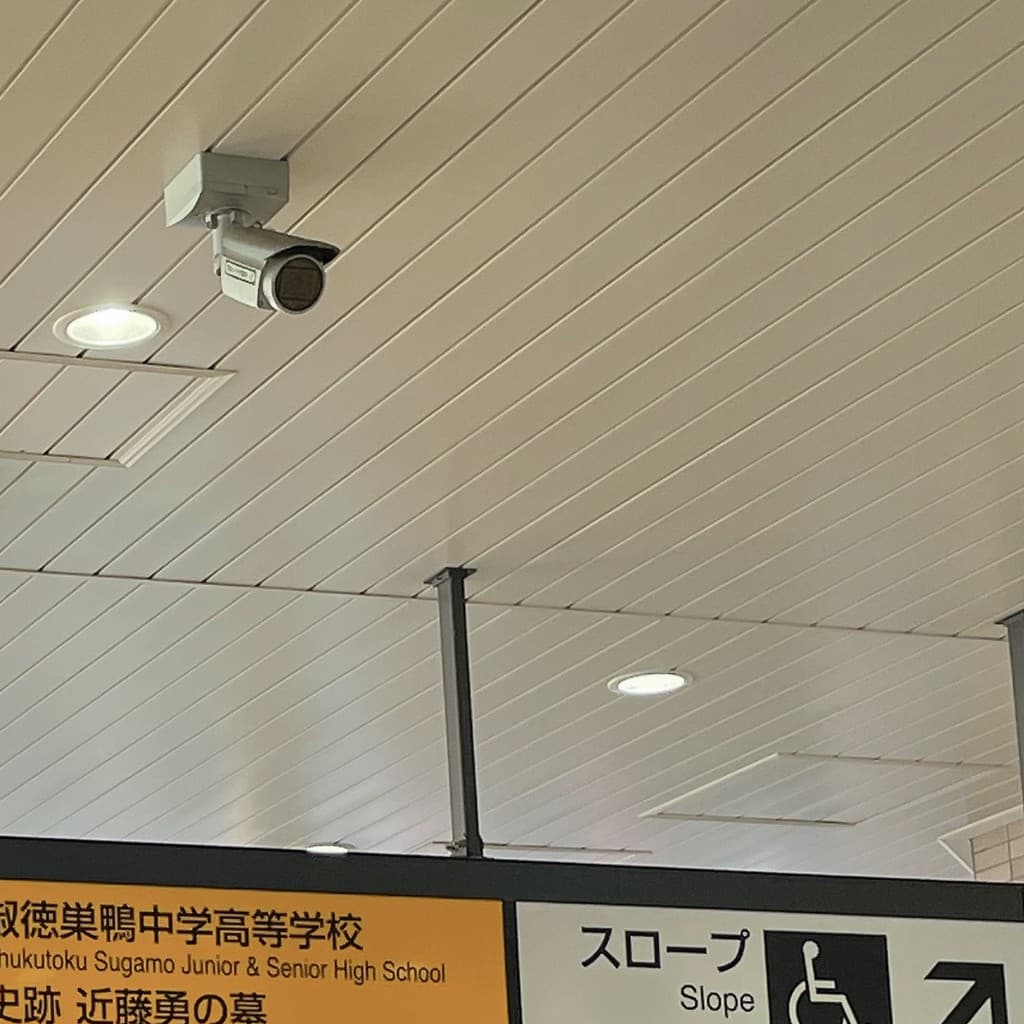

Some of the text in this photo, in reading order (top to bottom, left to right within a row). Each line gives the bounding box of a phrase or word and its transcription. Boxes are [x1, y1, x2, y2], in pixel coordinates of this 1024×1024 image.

[581, 926, 751, 973] スロープ
[94, 950, 176, 979] Sugamo
[181, 954, 241, 976] Junior
[246, 956, 260, 977] &
[266, 956, 329, 979] Senior
[334, 959, 376, 986] High
[382, 960, 446, 984] School
[680, 984, 755, 1019] Slope
